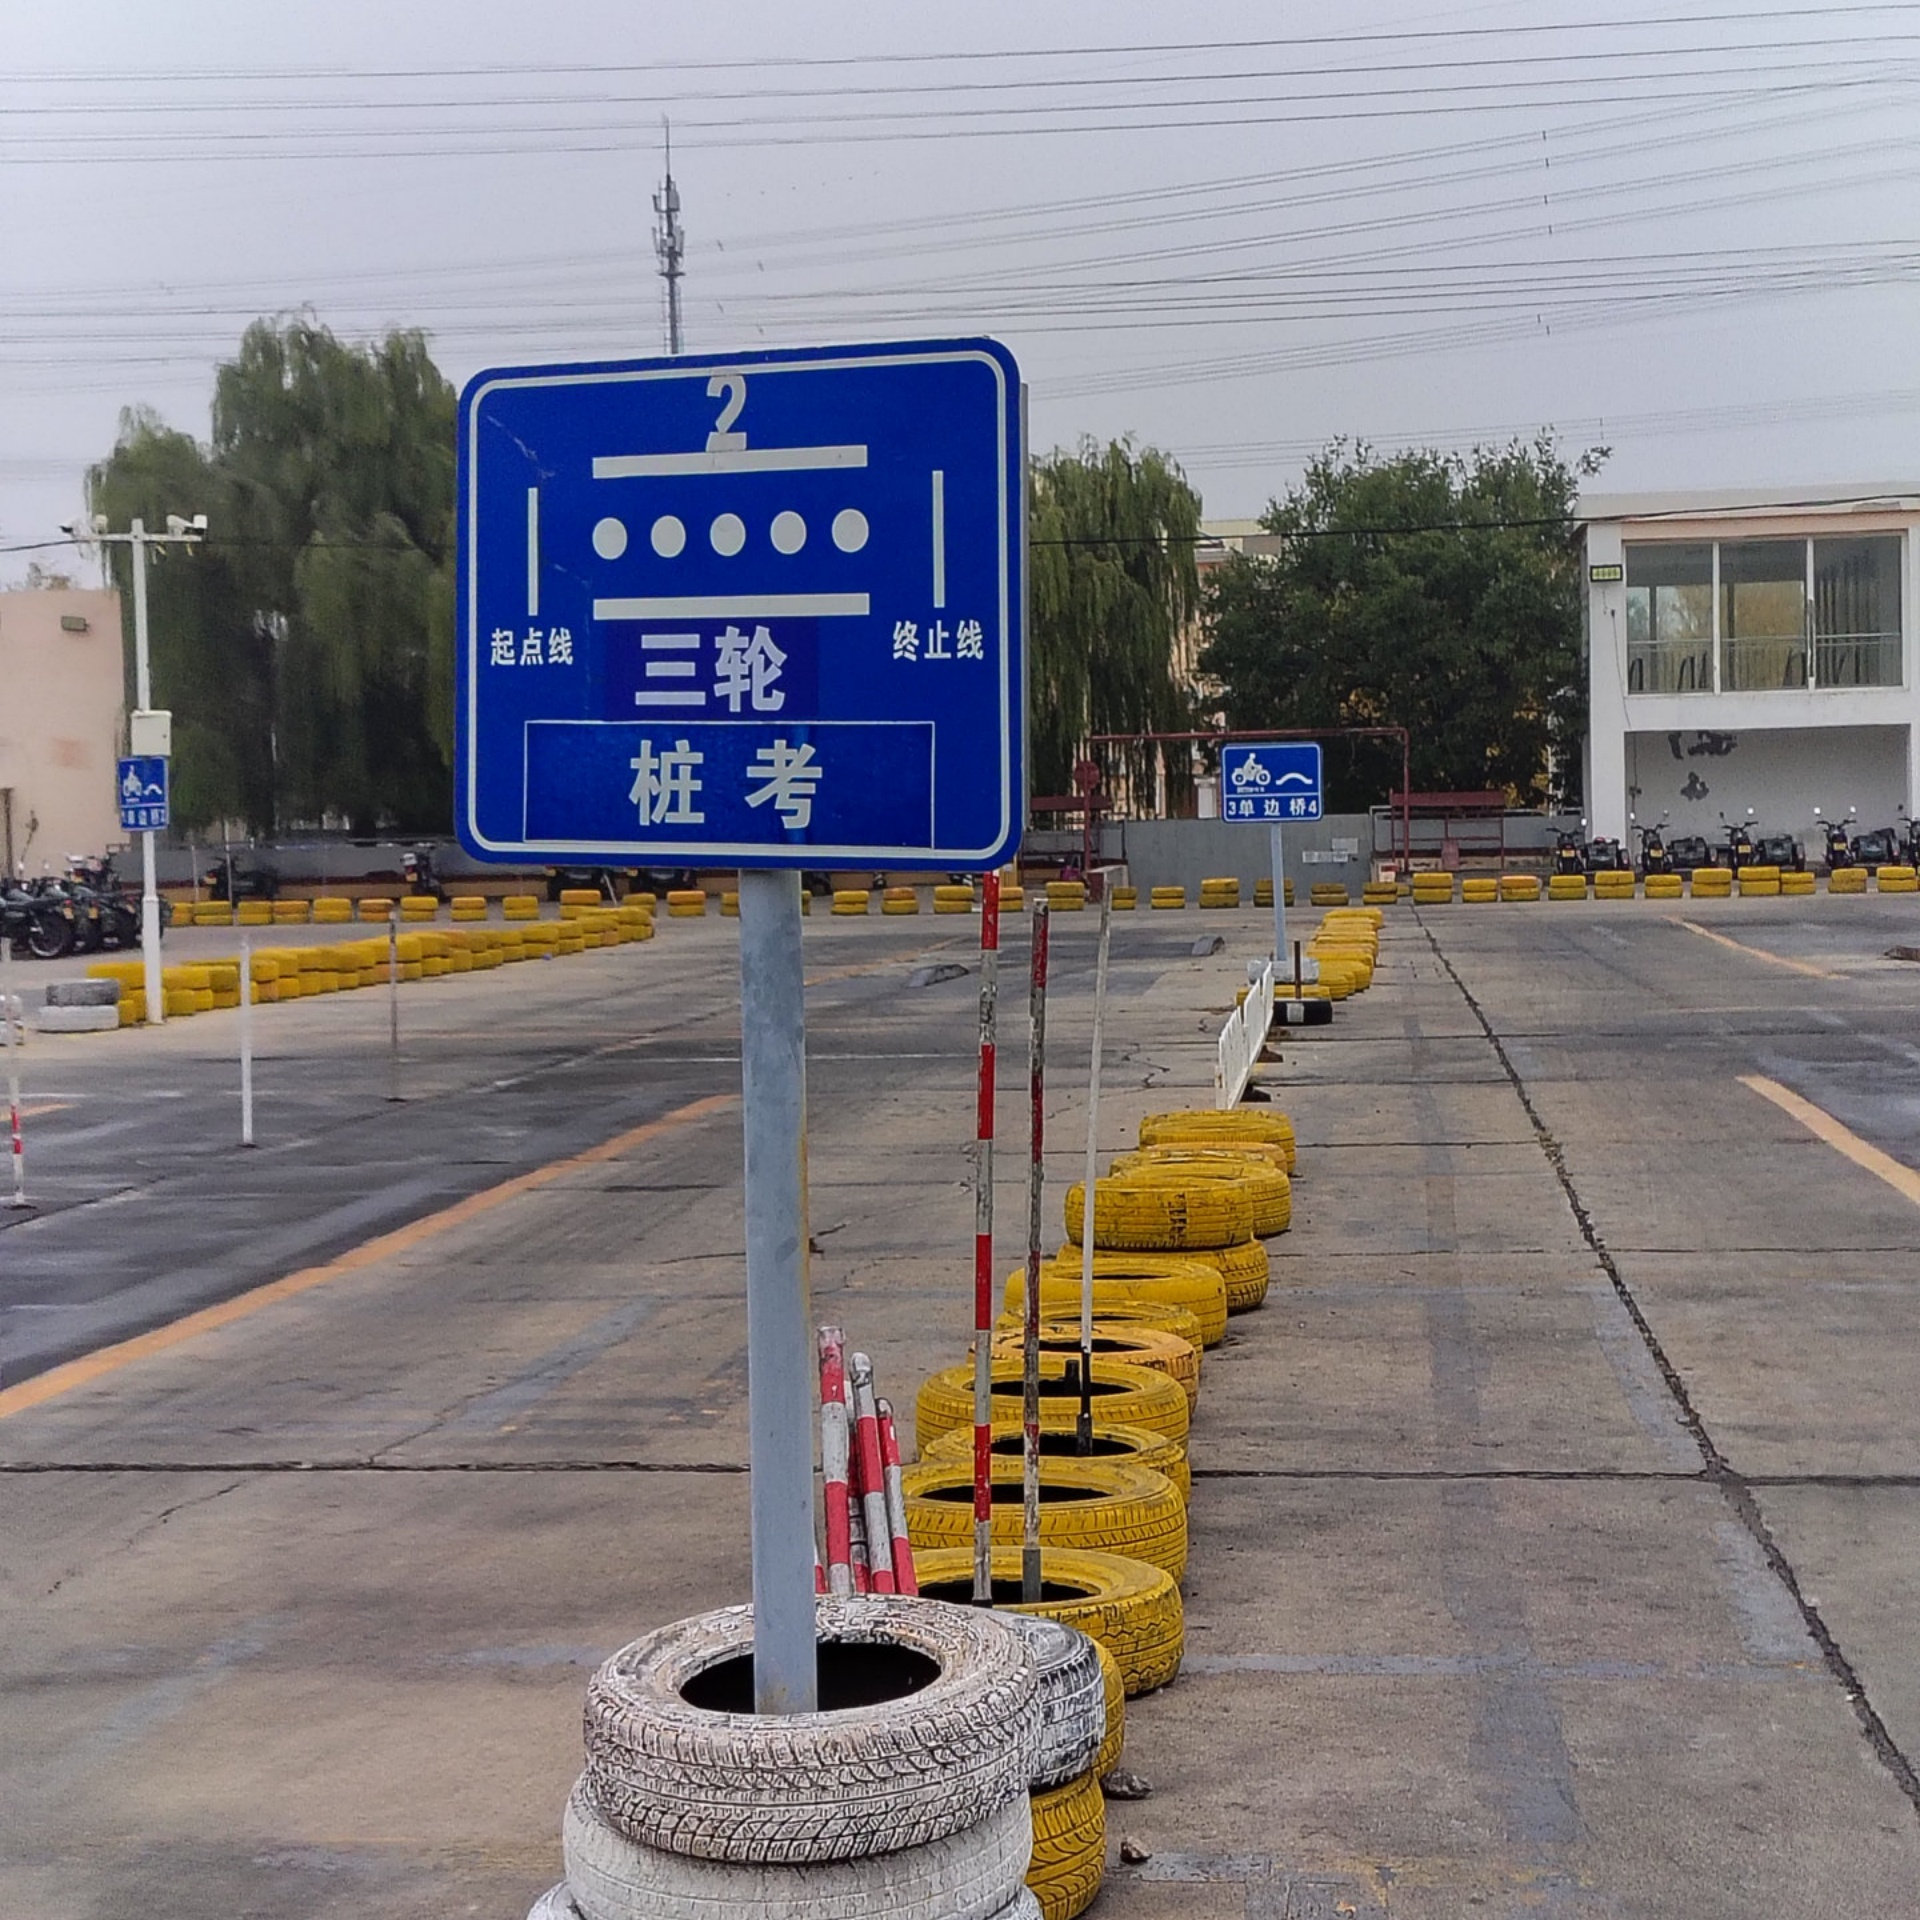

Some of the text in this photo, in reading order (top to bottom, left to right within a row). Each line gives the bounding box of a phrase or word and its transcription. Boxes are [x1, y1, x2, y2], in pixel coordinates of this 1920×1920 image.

[706, 374, 747, 451] 2
[490, 628, 573, 666] 起点线
[635, 626, 787, 712] 三轮
[892, 620, 984, 661] 终止线
[629, 740, 822, 829] 桩考
